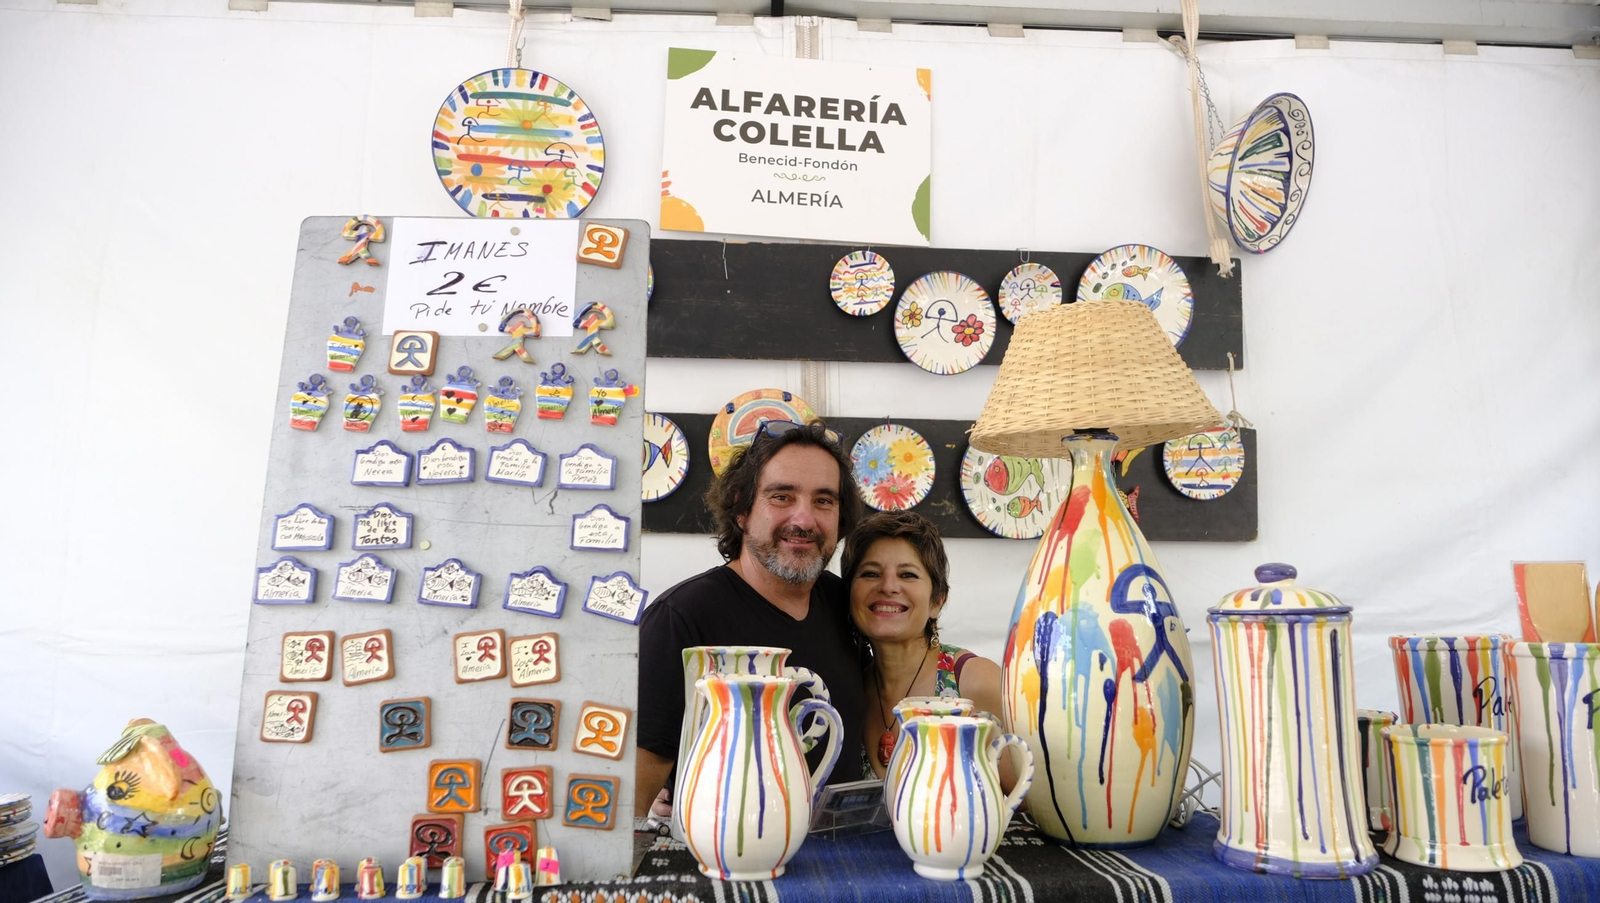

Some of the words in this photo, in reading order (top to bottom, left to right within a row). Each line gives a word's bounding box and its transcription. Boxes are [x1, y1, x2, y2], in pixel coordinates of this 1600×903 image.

[690, 86, 908, 126] ALFARERÍA
[713, 118, 885, 154] COLELLA
[738, 152, 858, 171] Benecid-Fondón
[751, 189, 844, 209] ALMERÍA
[409, 240, 529, 265] IMANES
[426, 271, 465, 296] 2
[472, 274, 507, 293] €
[410, 299, 452, 319] Pide
[373, 510, 392, 519] Dios
[377, 519, 397, 528] libre
[359, 534, 399, 545] Tontos
[366, 526, 378, 534] de
[579, 534, 618, 544] Familia
